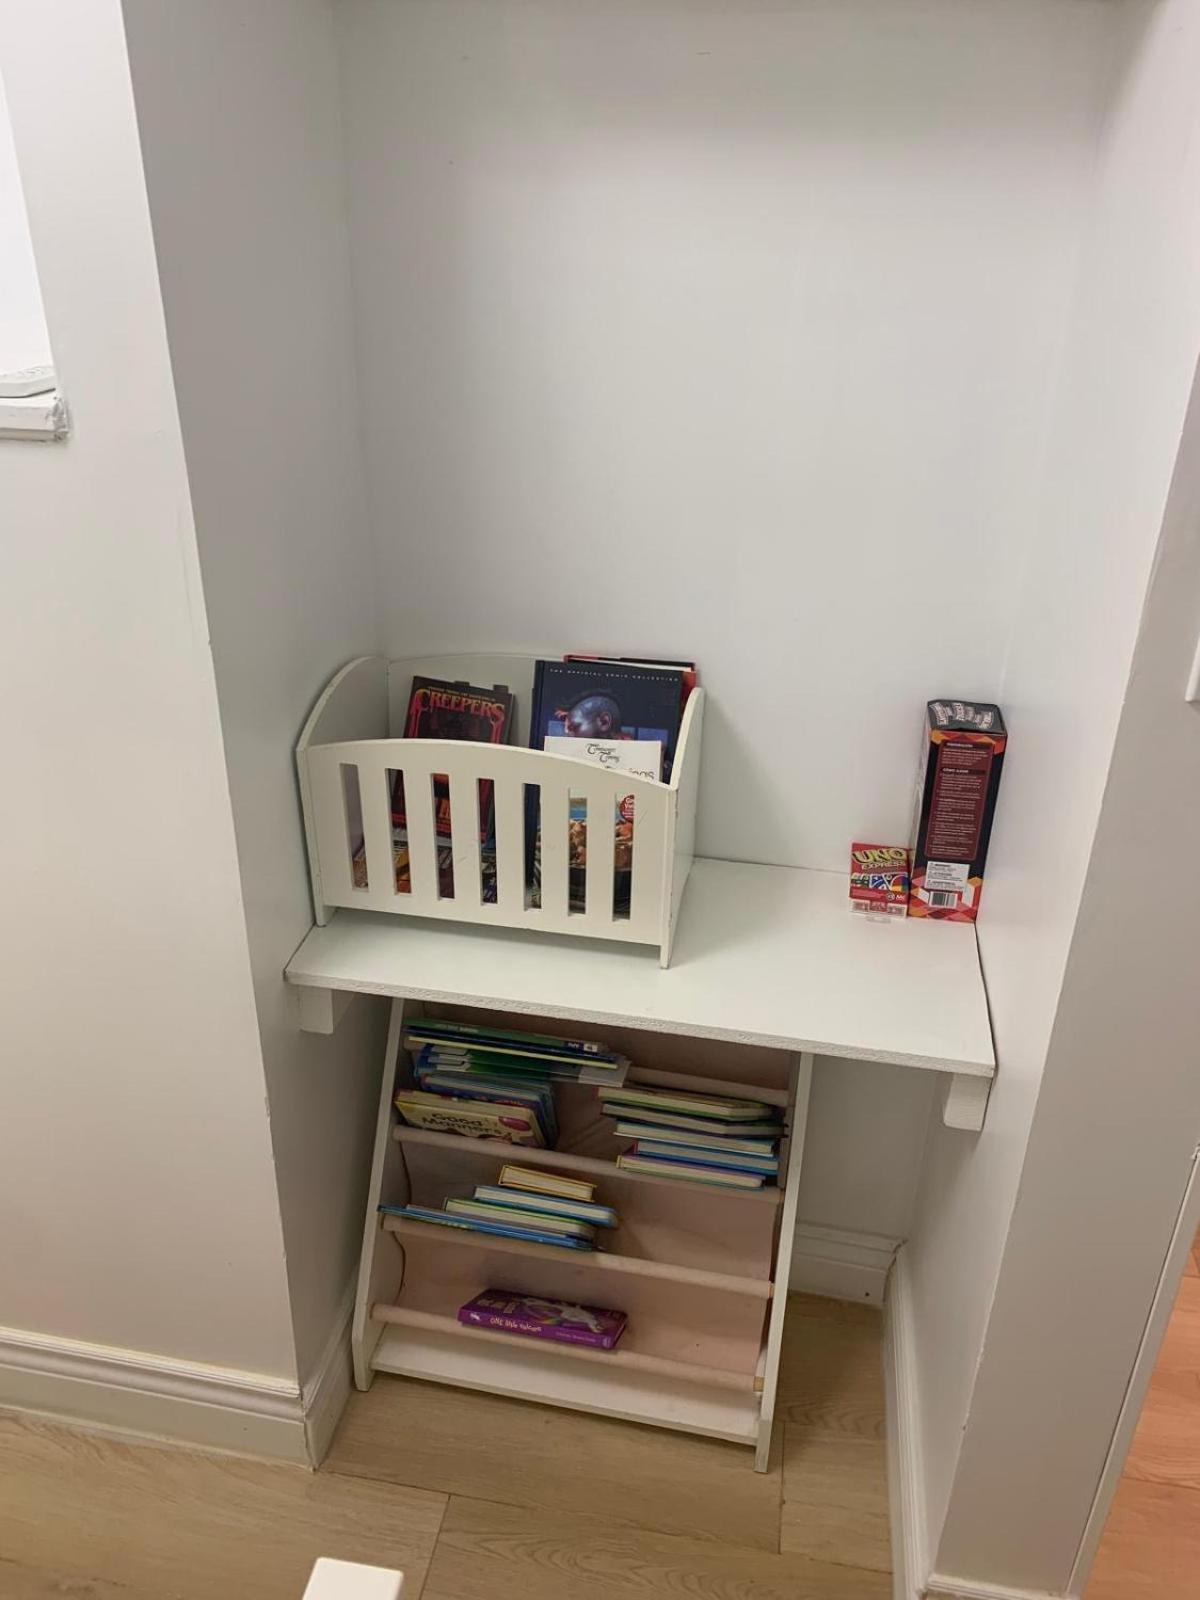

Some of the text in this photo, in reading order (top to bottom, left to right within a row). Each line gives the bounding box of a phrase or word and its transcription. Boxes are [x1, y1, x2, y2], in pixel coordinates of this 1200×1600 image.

[413, 688, 505, 720] CREEPERS
[852, 848, 907, 864] UNO
[861, 860, 906, 870] EXPRESS
[422, 1116, 502, 1135] Manners
[432, 1112, 482, 1126] Good
